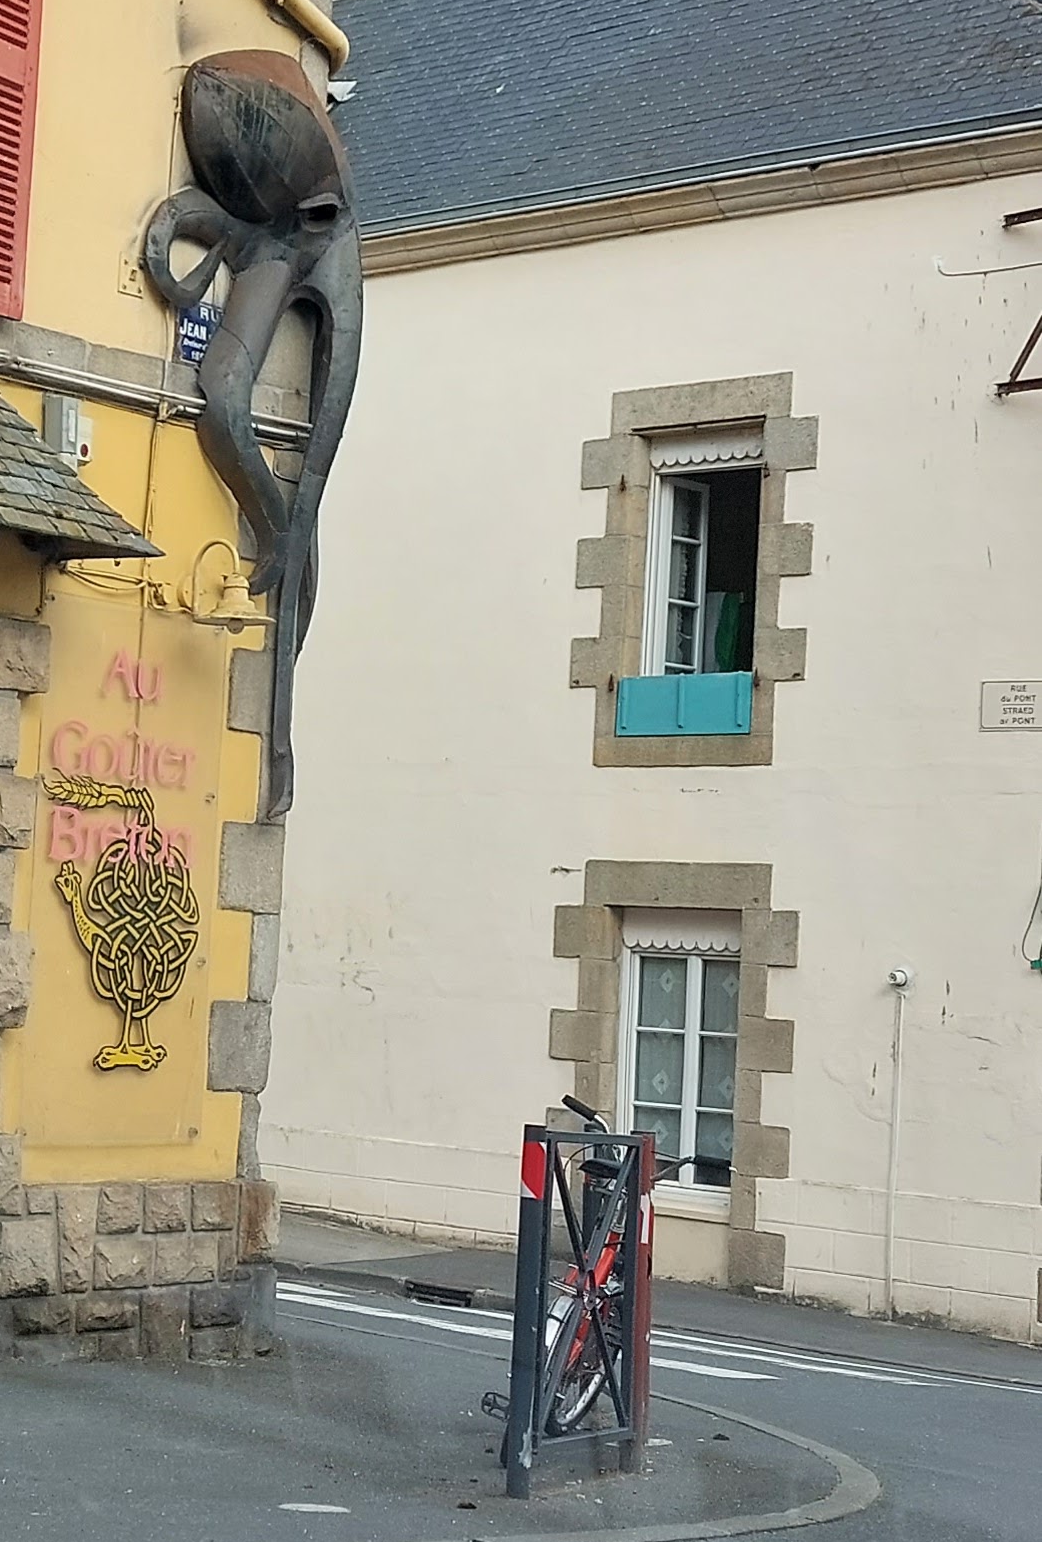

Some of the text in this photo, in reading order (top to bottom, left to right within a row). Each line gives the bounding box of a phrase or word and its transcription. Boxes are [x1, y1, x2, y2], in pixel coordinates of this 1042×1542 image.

[199, 306, 219, 324] RU
[179, 317, 207, 341] JEAN
[101, 646, 164, 703] Au
[1010, 684, 1027, 693] RUE
[1014, 694, 1036, 702] PONT
[1002, 707, 1034, 715] STRAED
[1012, 717, 1036, 725] PONT
[47, 805, 194, 870] Breton
